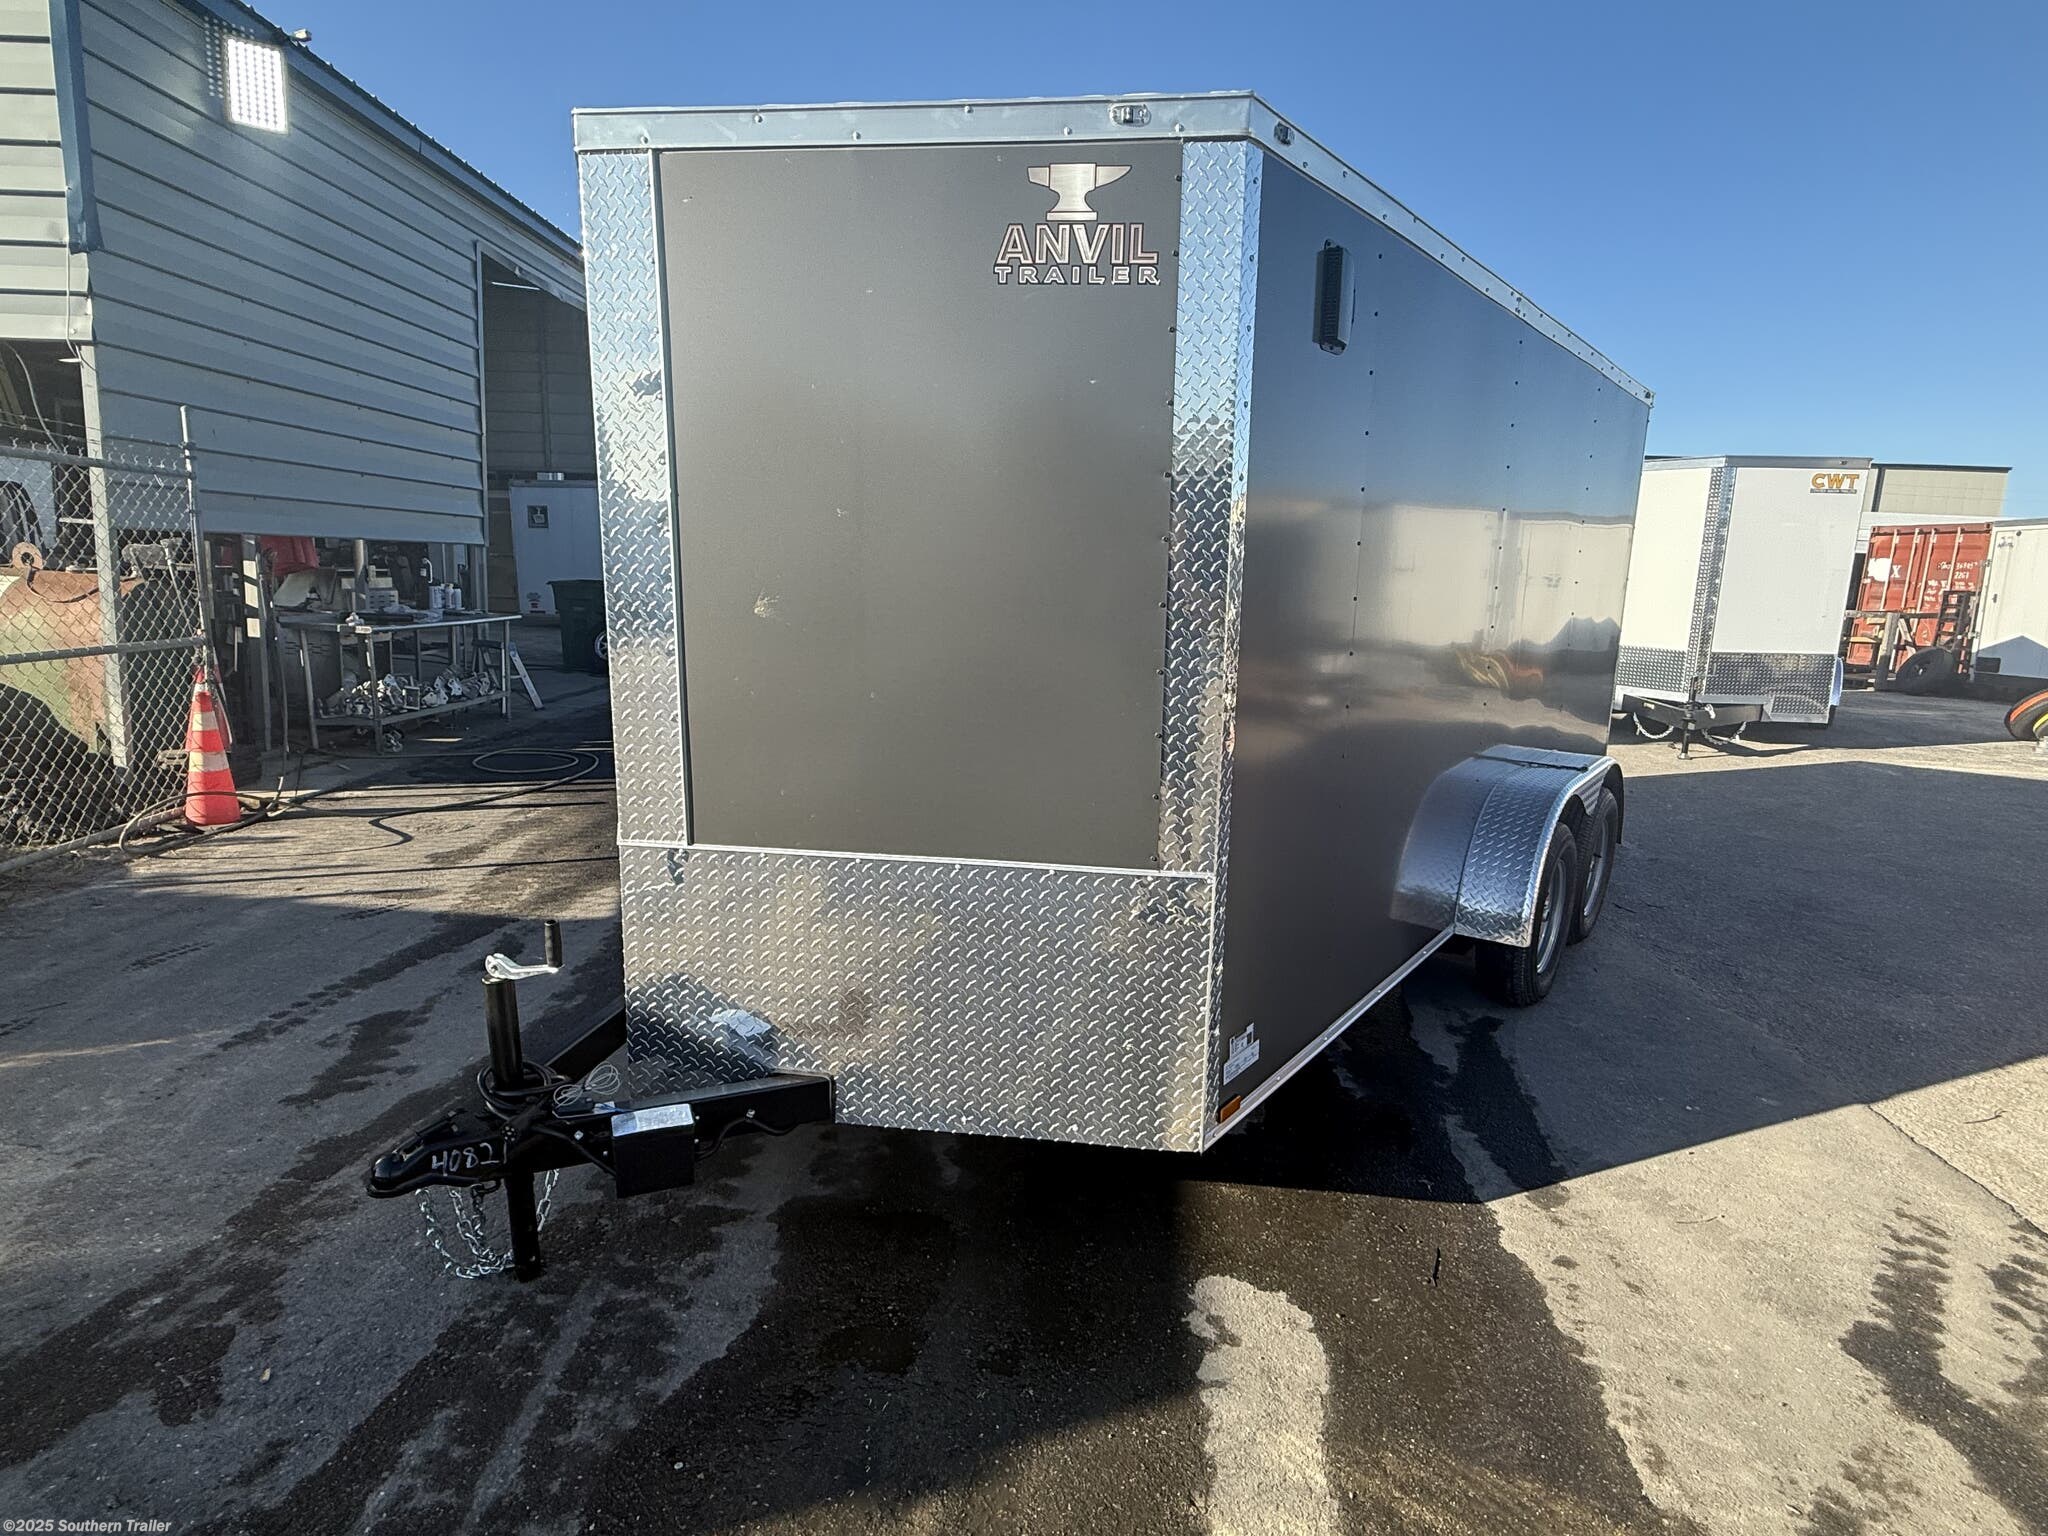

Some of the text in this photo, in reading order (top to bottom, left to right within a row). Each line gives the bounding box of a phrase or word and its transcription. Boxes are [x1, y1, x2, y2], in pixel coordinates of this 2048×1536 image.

[993, 222, 1159, 266] ANVIL
[992, 264, 1162, 286] TRAILER
[1811, 472, 1860, 489] CWT
[431, 1142, 500, 1177] 4082
